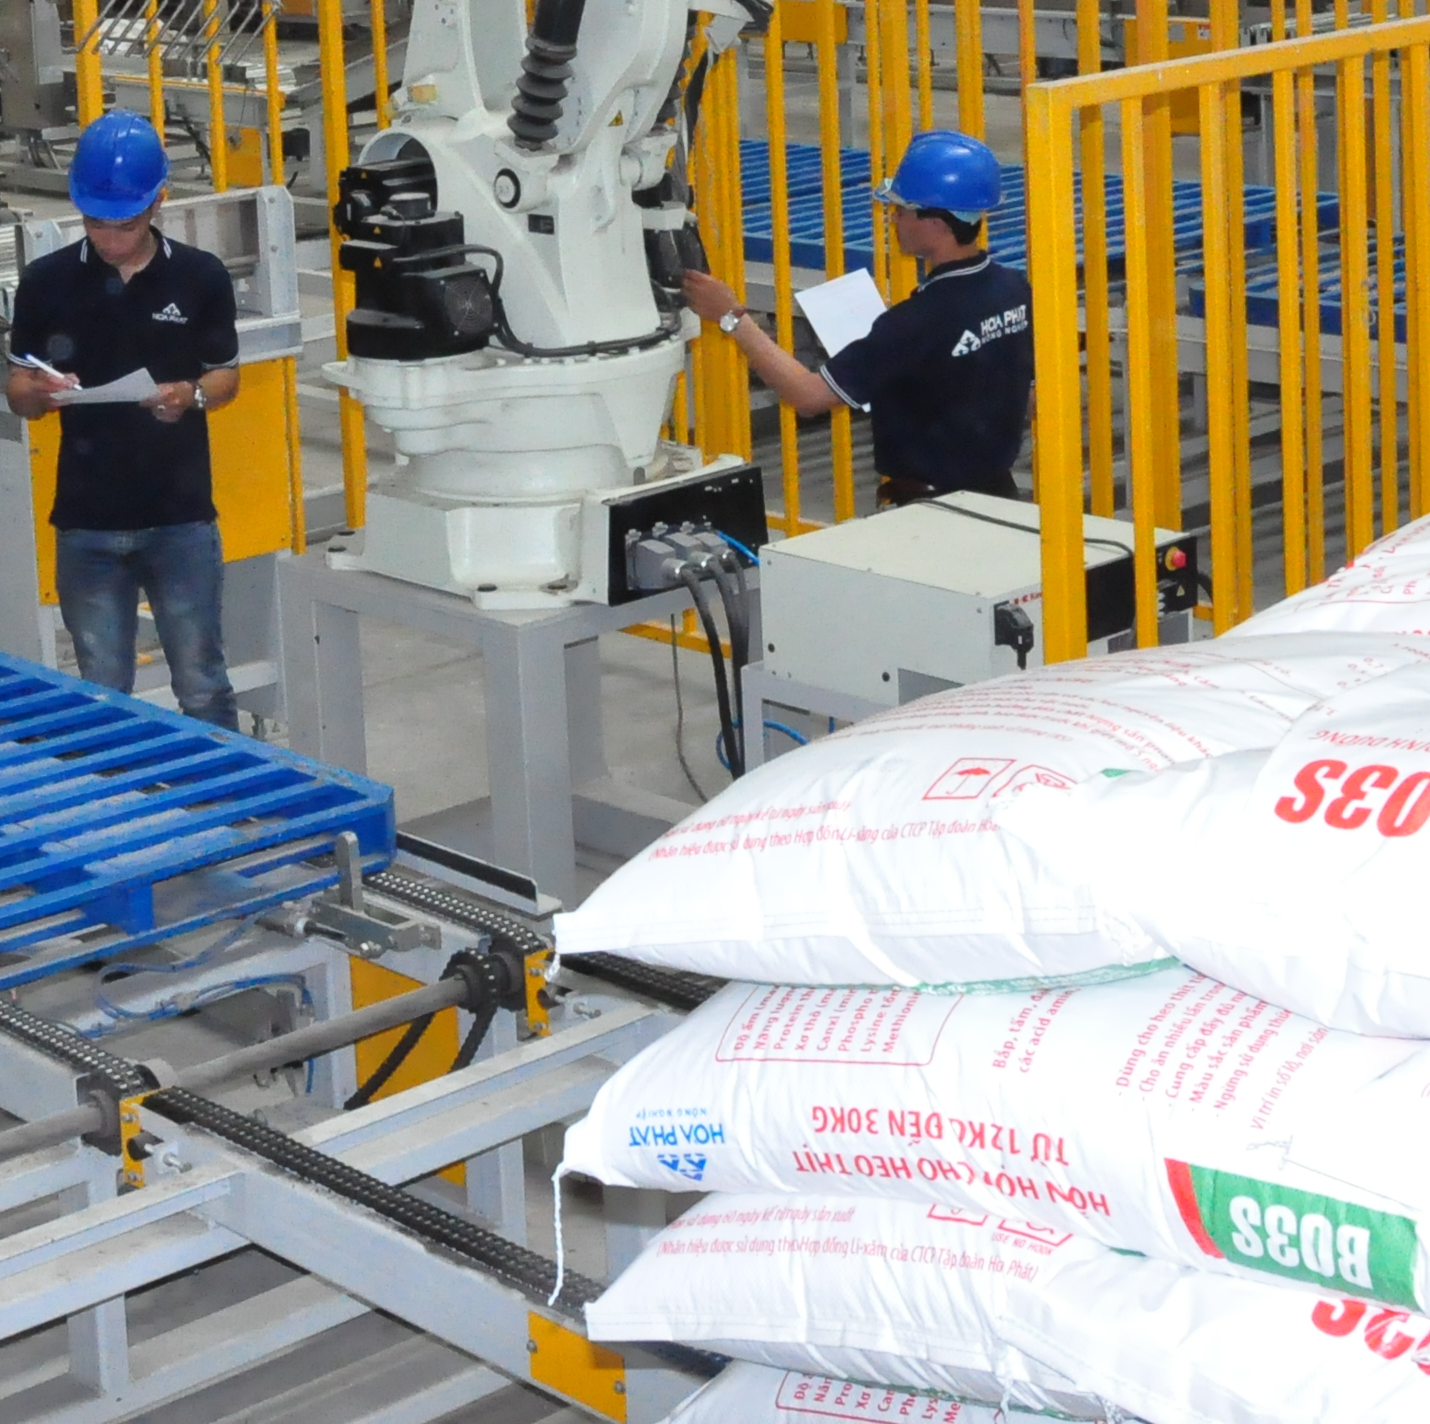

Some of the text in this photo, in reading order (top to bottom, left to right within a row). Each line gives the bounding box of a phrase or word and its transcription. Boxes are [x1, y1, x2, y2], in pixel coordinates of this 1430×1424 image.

[1308, 729, 1389, 750] DƯỠNG
[838, 998, 872, 1051] Phospho
[861, 1007, 885, 1052] Lysine
[1020, 1018, 1050, 1073] các acid
[1116, 985, 1193, 1087] Dùng cho heo thịt
[1140, 1003, 1204, 1092] Cho ăn nhiều lần
[1166, 999, 1235, 1098] Cung cấp đầy đủ
[1189, 999, 1273, 1102] Màu sắc sản phẩm
[1214, 1029, 1278, 1109] Ngừng sử dụng
[812, 1105, 879, 1134] 30KG
[887, 1109, 945, 1147] ĐẾN
[791, 1144, 854, 1175] THỊT
[853, 1154, 913, 1179] HEO
[917, 1159, 976, 1184] CHO
[1032, 1132, 1069, 1168] TỪ
